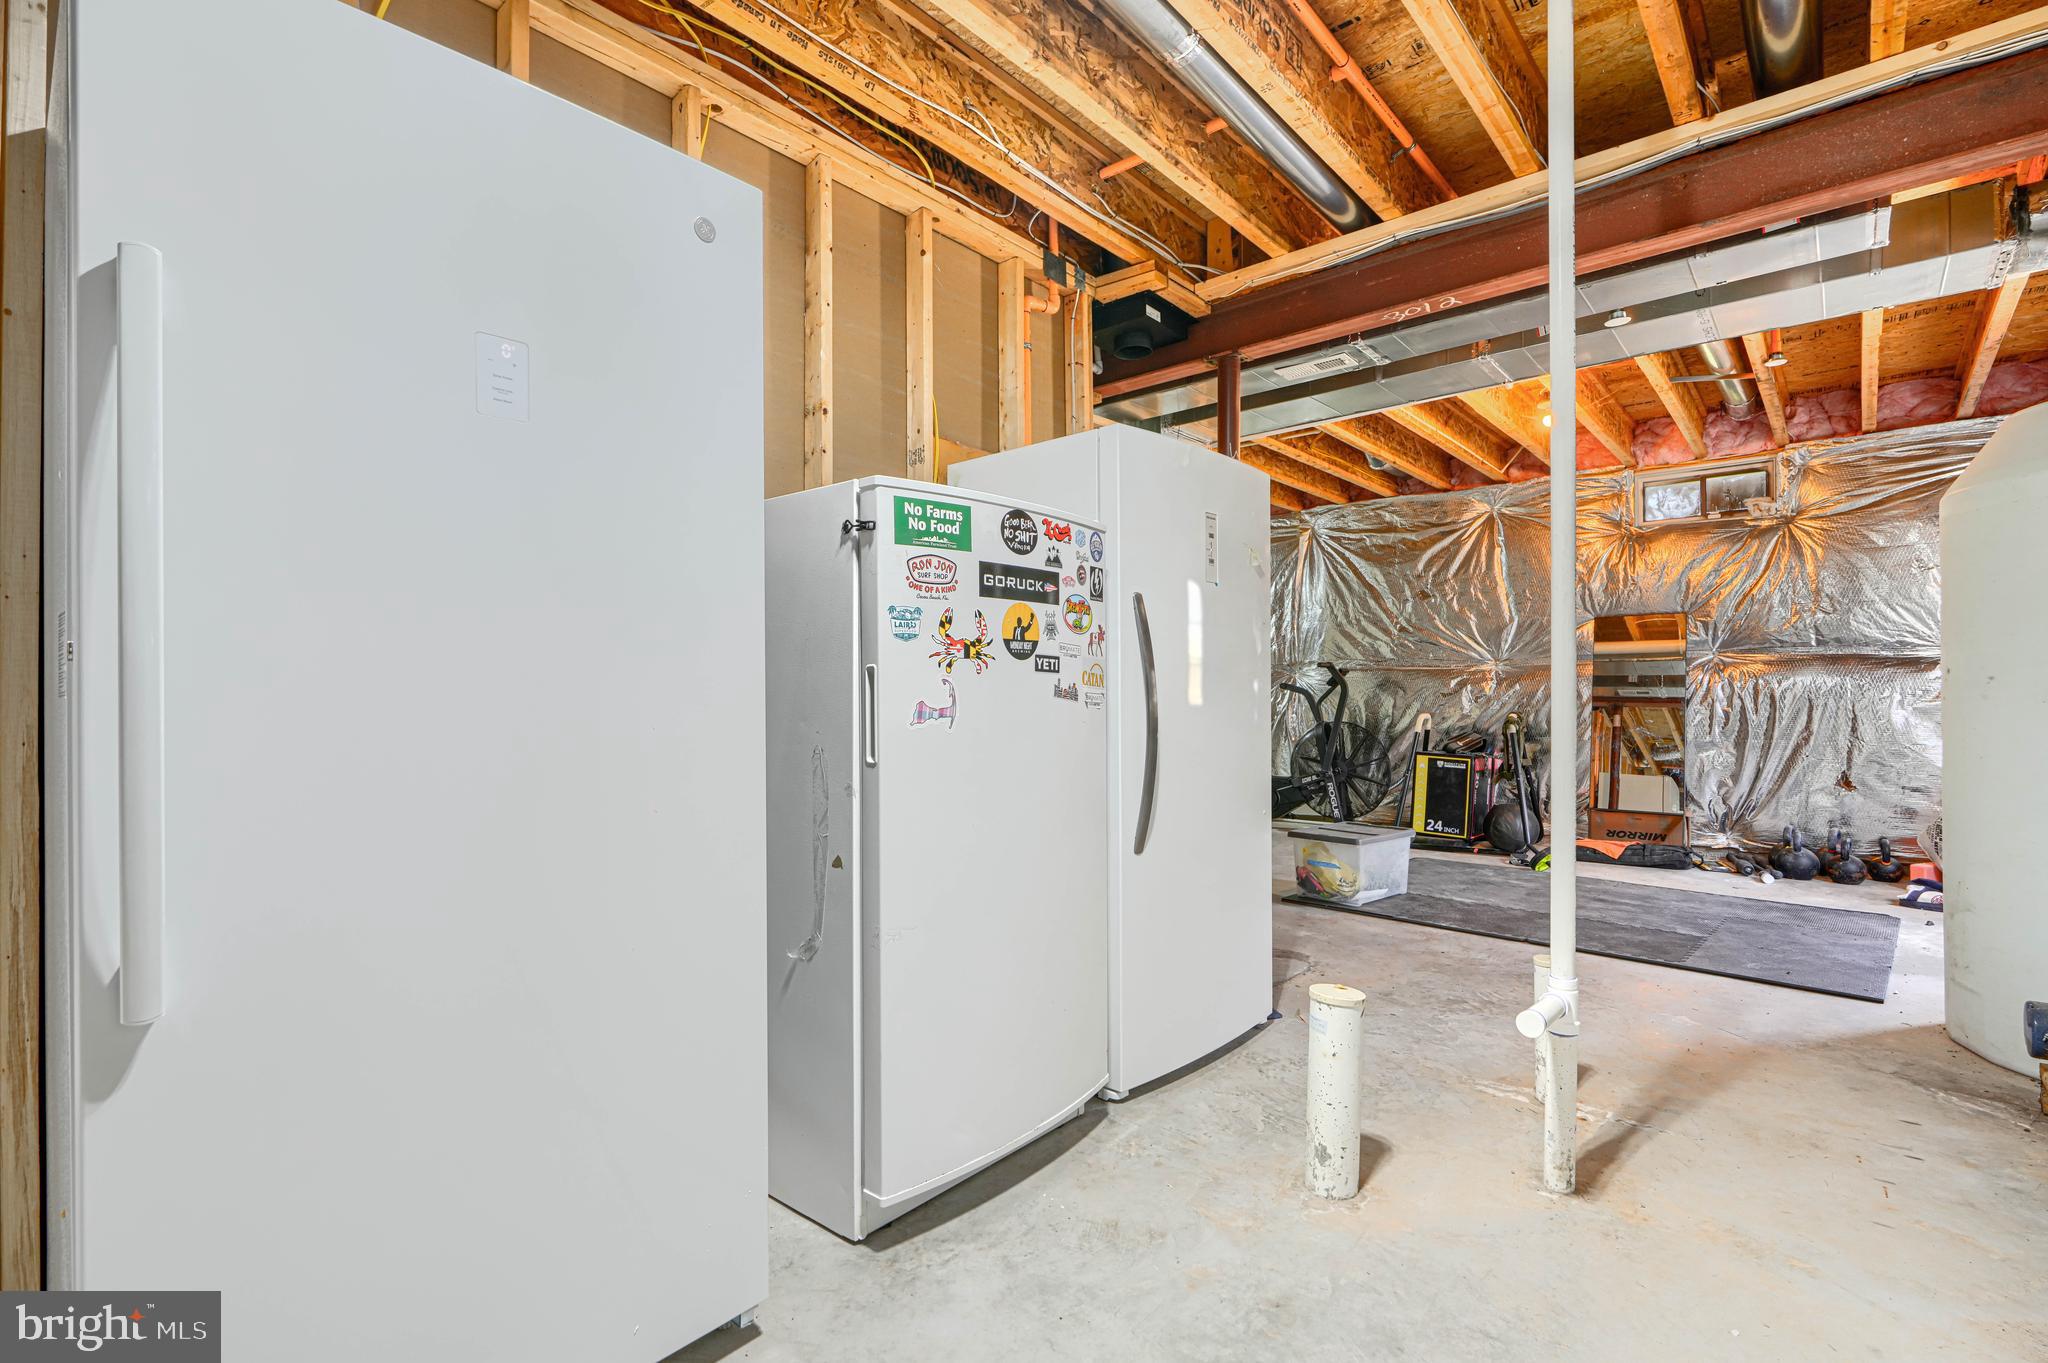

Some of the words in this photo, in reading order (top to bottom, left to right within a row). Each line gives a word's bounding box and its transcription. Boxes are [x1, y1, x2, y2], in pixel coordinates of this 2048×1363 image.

[769, 19, 781, 32] in
[786, 31, 809, 50] Made
[1382, 296, 1462, 322] 3012
[904, 502, 922, 516] No
[926, 504, 963, 521] Farms
[908, 517, 927, 531] No
[930, 519, 960, 535] Food
[1003, 527, 1014, 539] NO
[1015, 530, 1037, 545] SHIT
[911, 558, 933, 573] RON
[934, 560, 954, 574] JON
[908, 580, 924, 592] ONE
[924, 585, 934, 594] OF
[935, 586, 941, 594] A
[940, 584, 957, 594] KIND
[983, 574, 1044, 592] GORUCK
[1035, 657, 1059, 671] YETI
[1081, 670, 1105, 688] CATAN
[1326, 782, 1341, 819] ROGUE
[1426, 819, 1443, 832] 24
[1605, 828, 1669, 842] MIRROR
